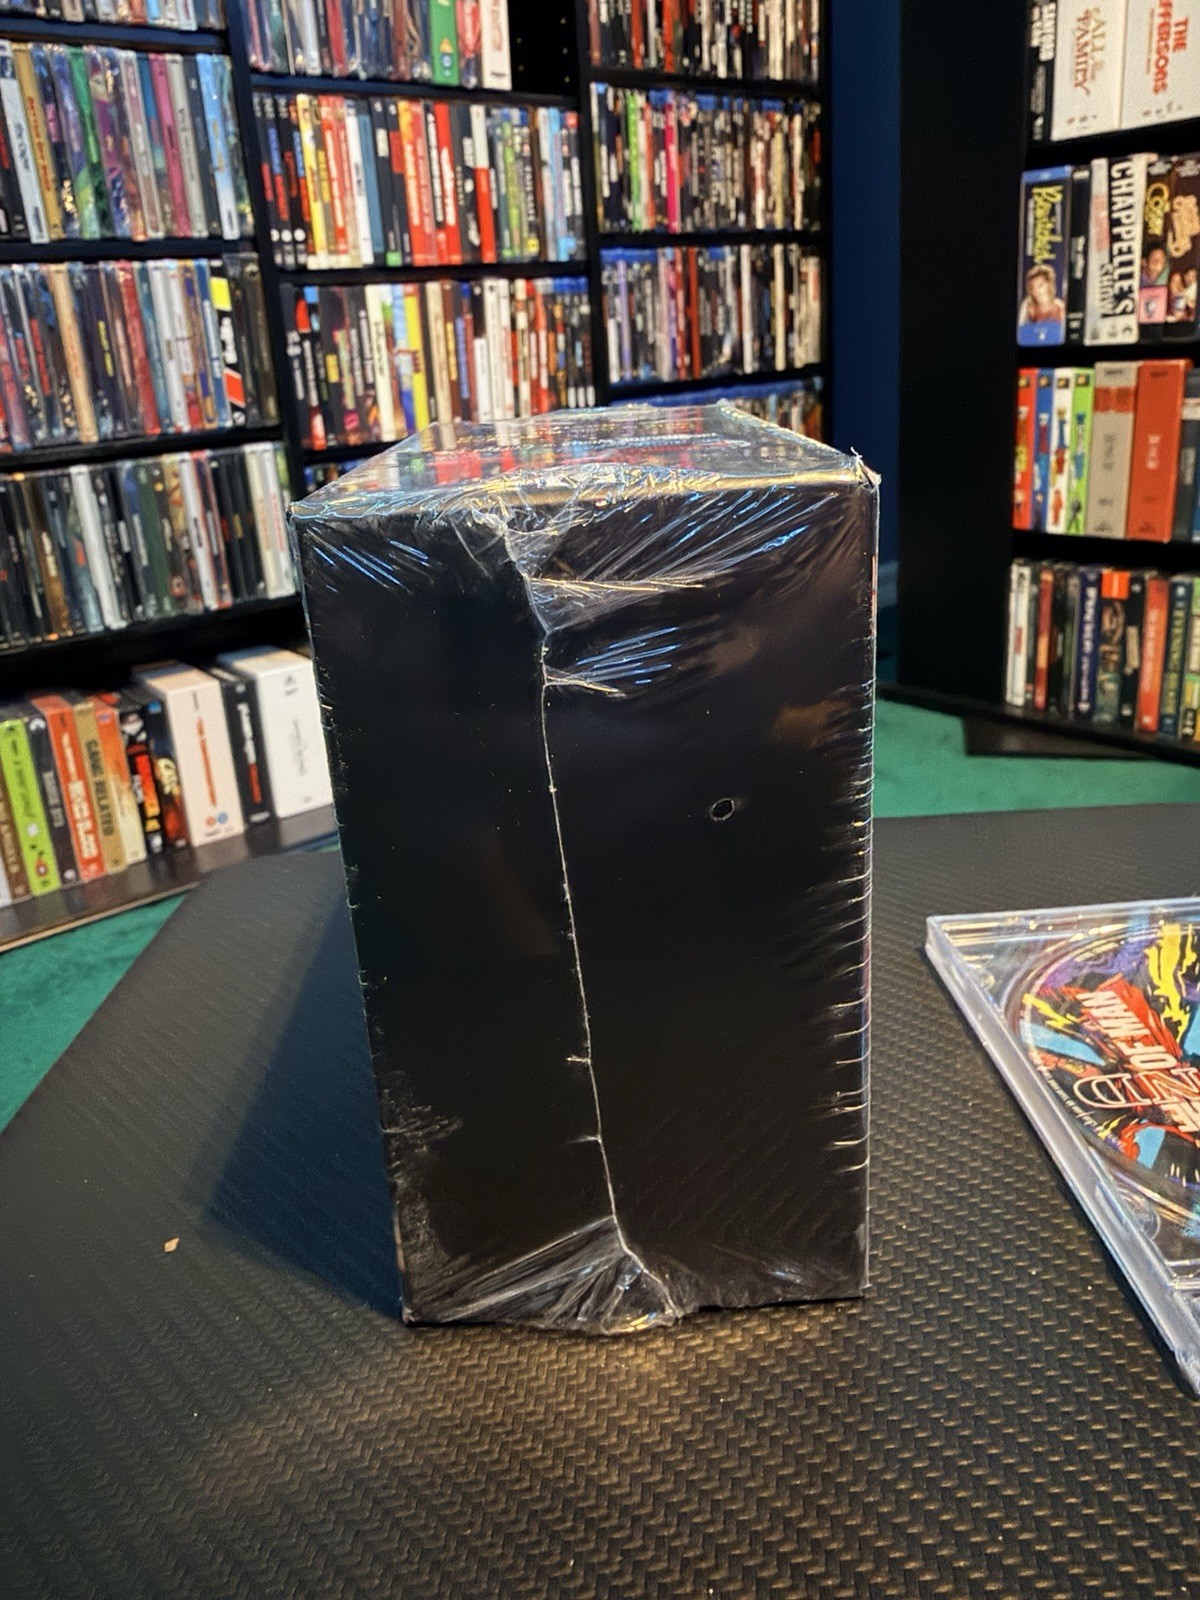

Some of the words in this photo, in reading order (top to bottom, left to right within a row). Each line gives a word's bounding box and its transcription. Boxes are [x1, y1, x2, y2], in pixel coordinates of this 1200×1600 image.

[1073, 9, 1091, 95] FAMILY
[1153, 0, 1172, 94] FFERSONS
[1173, 17, 1188, 52] THE
[1110, 161, 1134, 316] CHAPPELLE'S
[1100, 262, 1116, 319] SHOW
[1076, 990, 1150, 1038] MAN
[1117, 1041, 1178, 1070] OF
